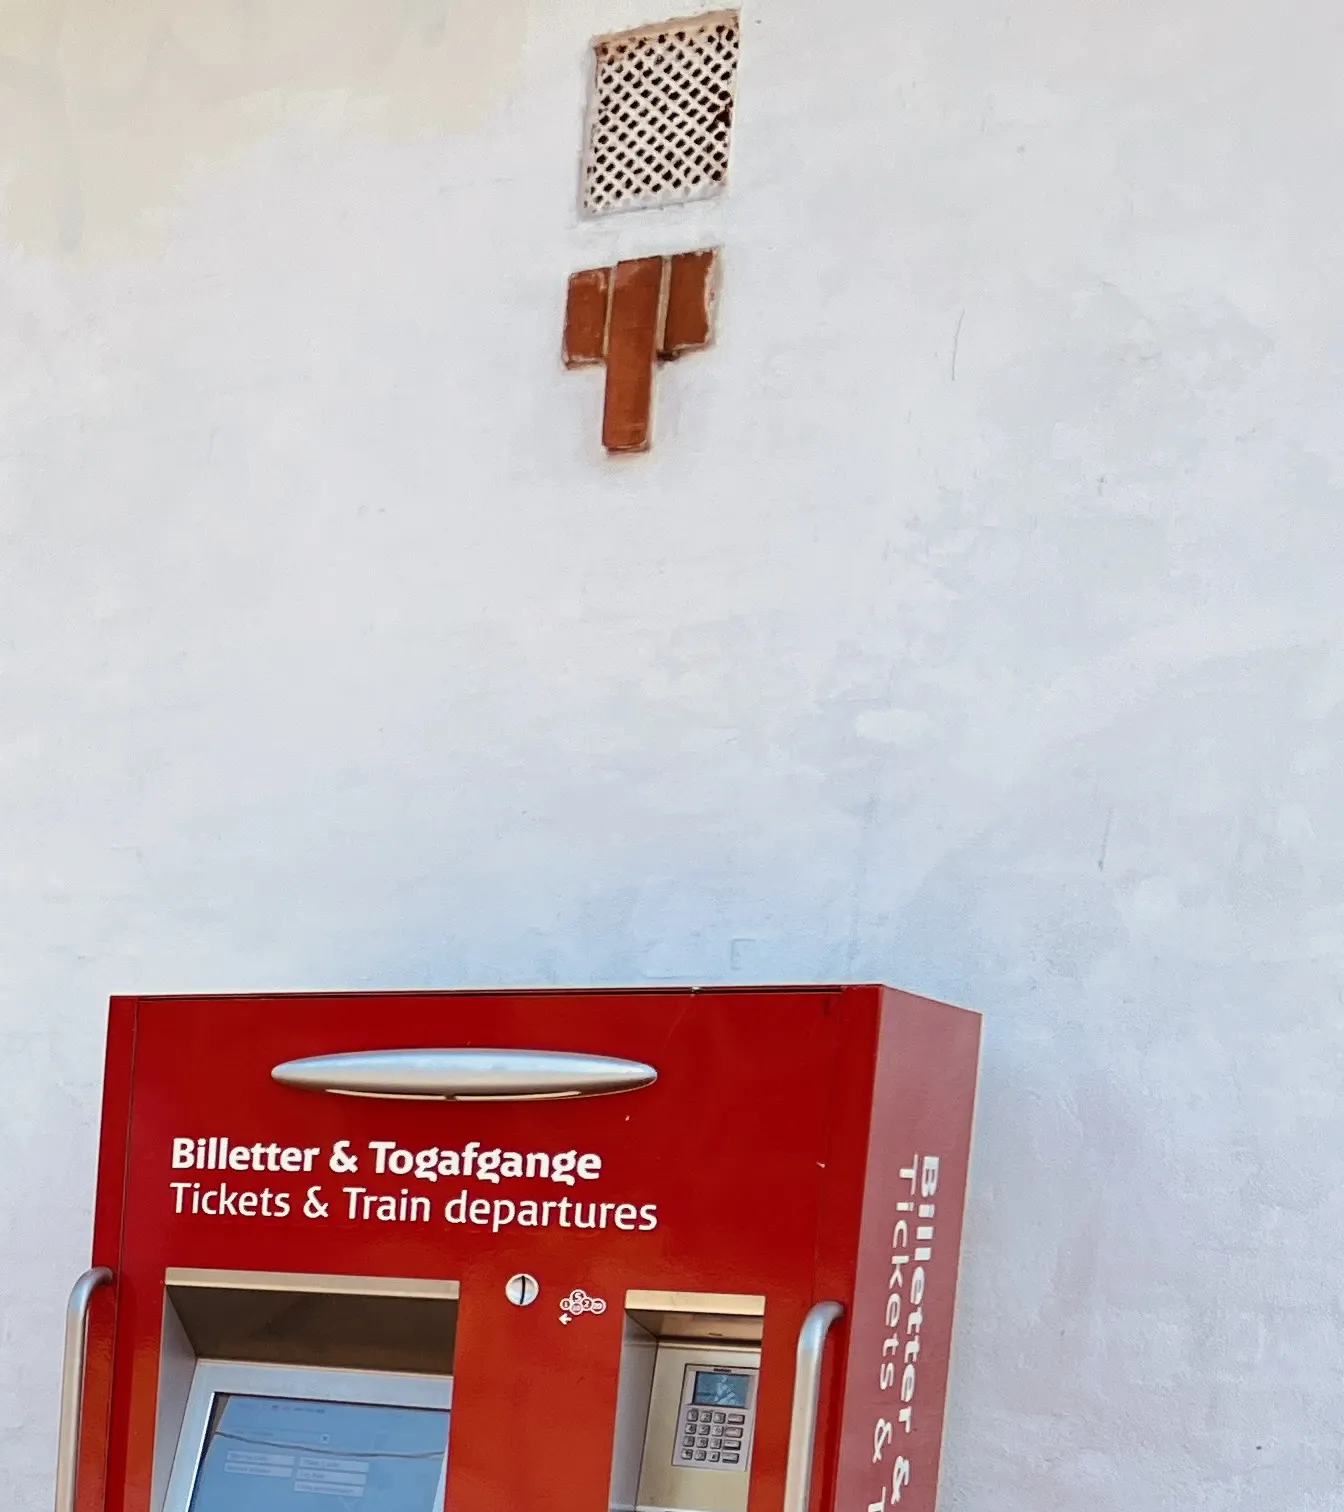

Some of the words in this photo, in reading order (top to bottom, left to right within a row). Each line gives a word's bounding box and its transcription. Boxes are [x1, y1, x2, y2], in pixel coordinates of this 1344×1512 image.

[171, 1137, 320, 1172] Billetter
[328, 1140, 359, 1174] &
[368, 1141, 602, 1186] Togafgange
[169, 1182, 291, 1218] Tickets
[302, 1186, 329, 1219] &
[342, 1187, 431, 1221] Train
[444, 1189, 658, 1233] departures
[879, 1153, 919, 1391] Tickets
[897, 1155, 940, 1433] Billetter
[872, 1418, 893, 1464] &
[890, 1455, 910, 1506] &
